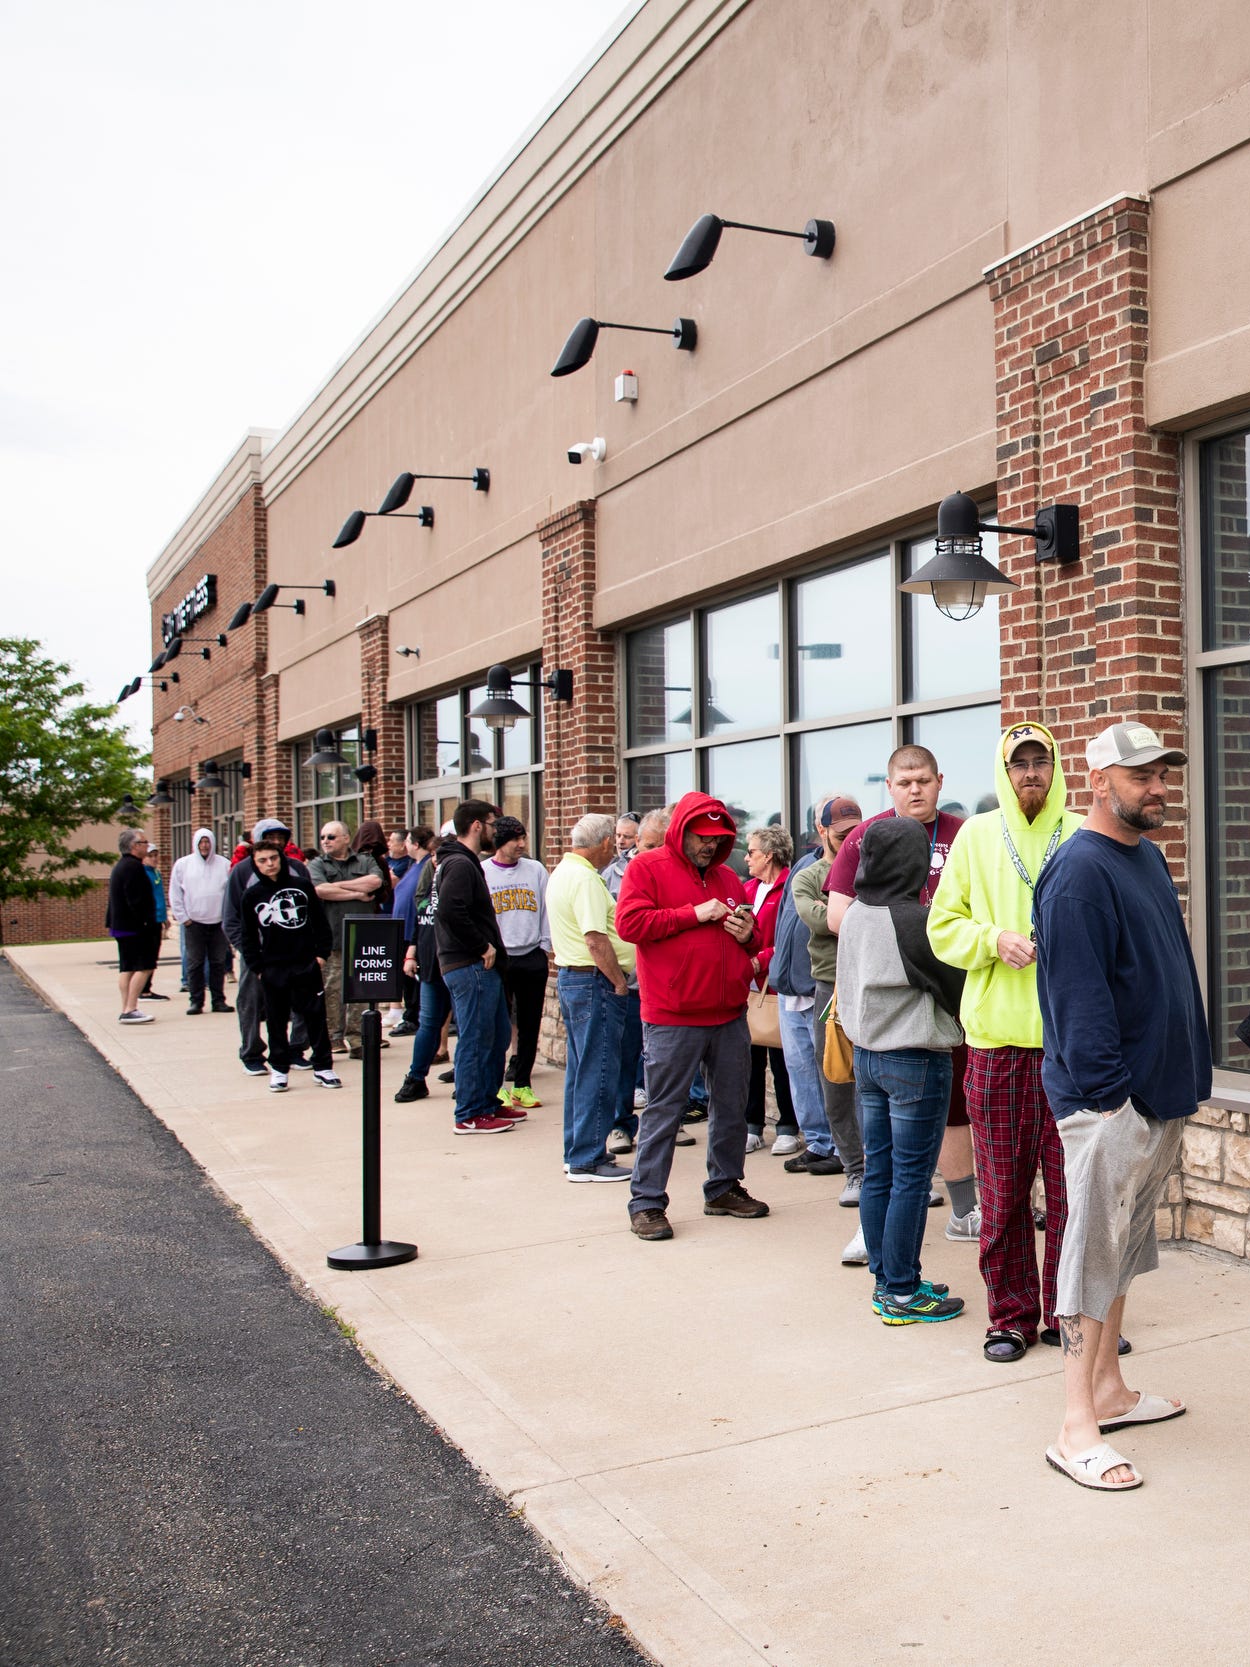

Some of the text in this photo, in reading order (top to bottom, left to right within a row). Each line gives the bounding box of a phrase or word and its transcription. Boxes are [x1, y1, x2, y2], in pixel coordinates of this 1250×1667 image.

[1011, 727, 1032, 740] M
[490, 888, 537, 914] USKIES
[362, 946, 386, 956] LINE
[354, 959, 393, 969] FORMS
[359, 972, 387, 982] HERE
